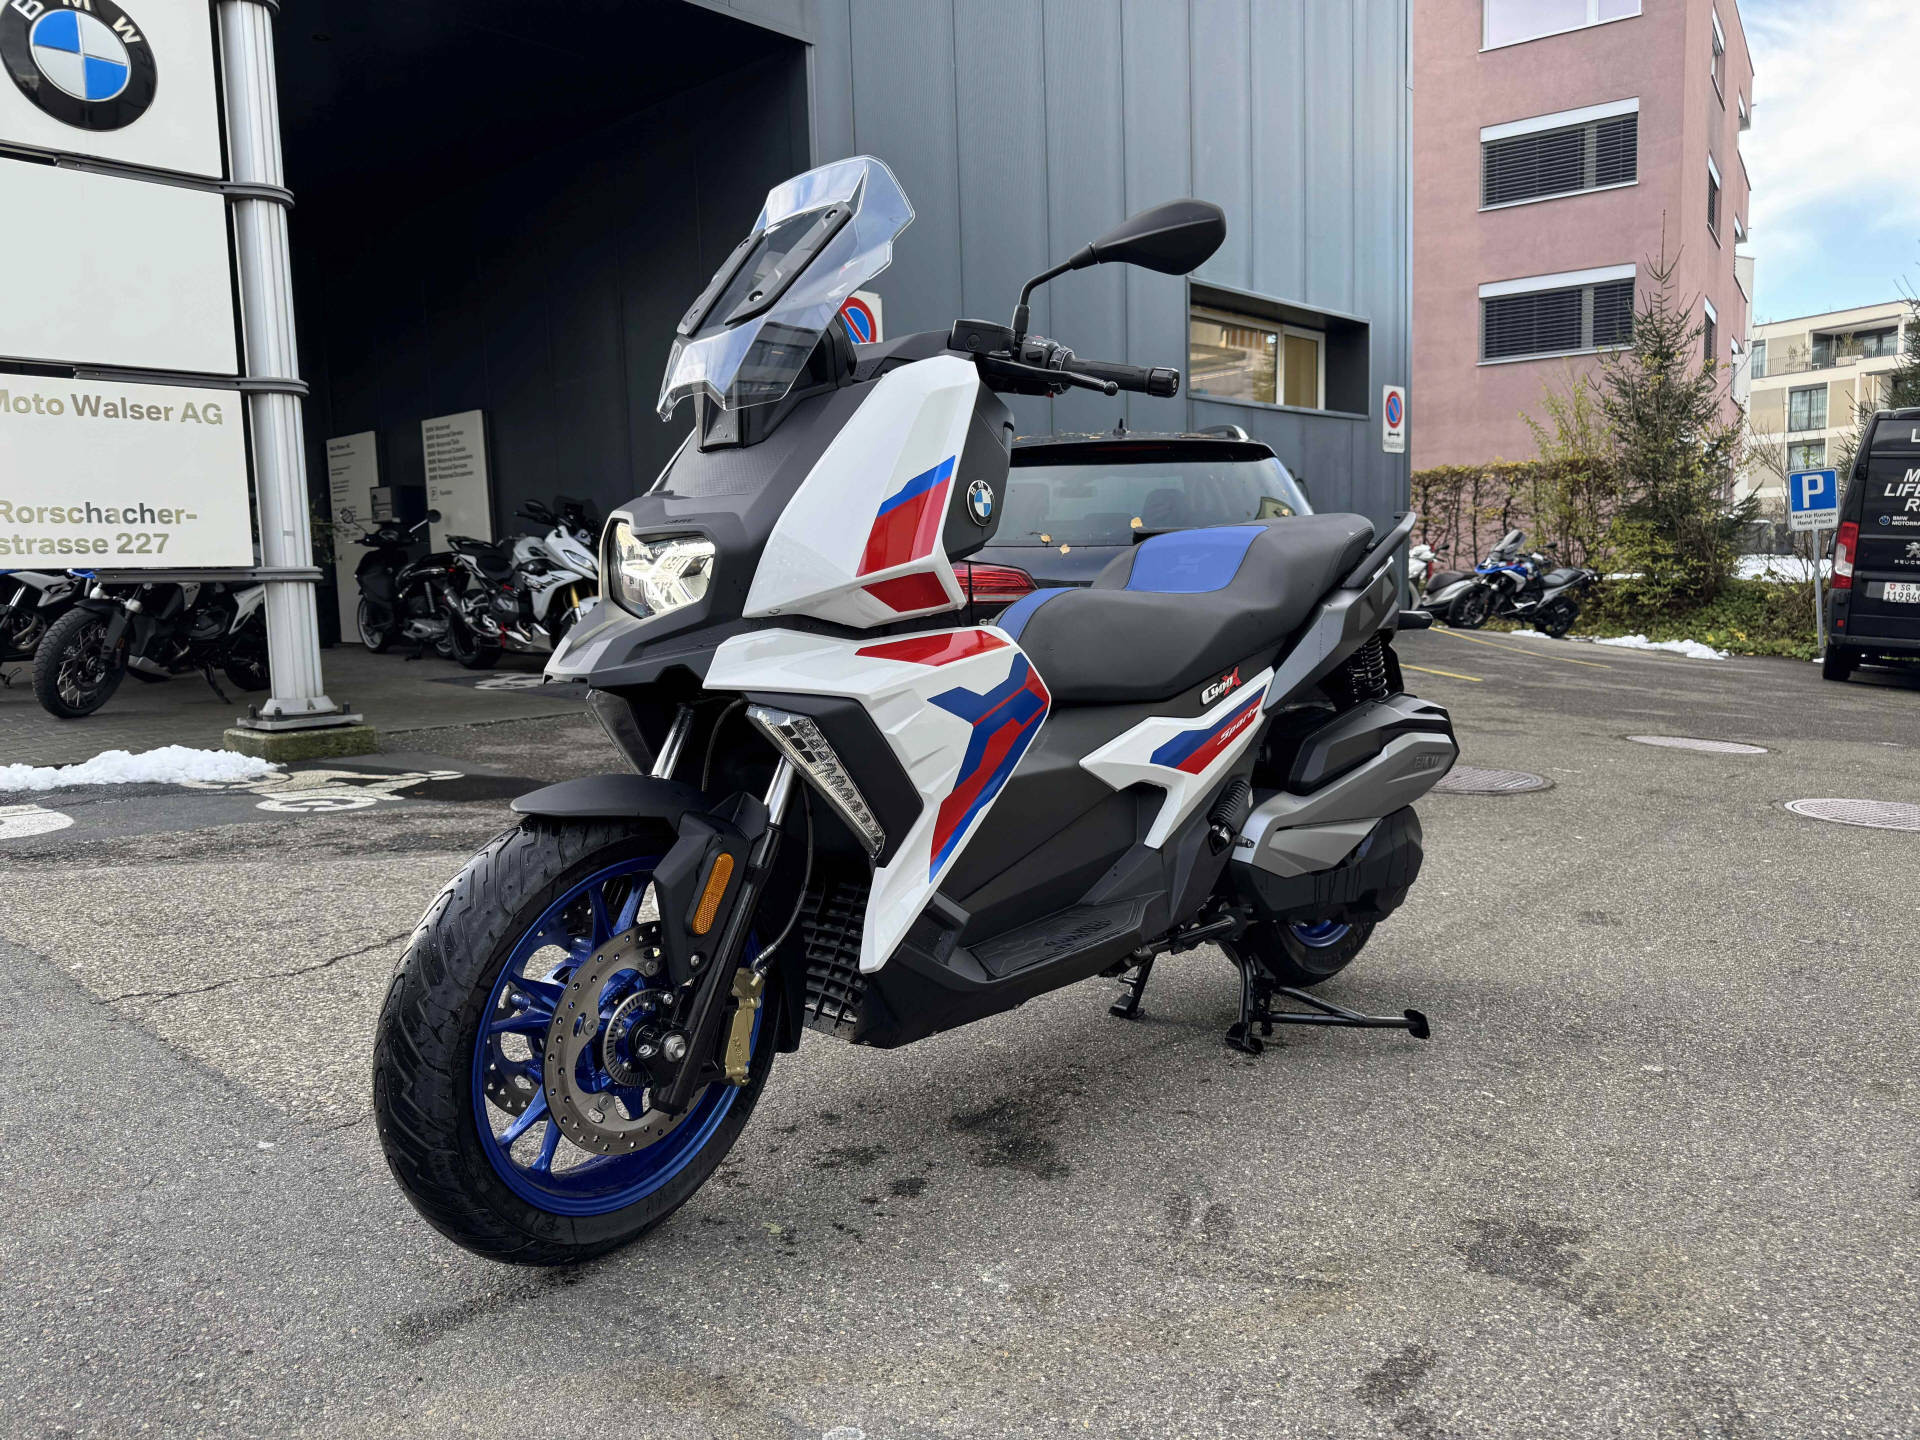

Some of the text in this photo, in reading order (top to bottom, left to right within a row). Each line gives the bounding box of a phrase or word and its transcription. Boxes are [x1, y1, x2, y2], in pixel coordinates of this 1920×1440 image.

[70, 393, 174, 422] Walser
[180, 402, 223, 425] AG
[1903, 468, 1920, 482] M
[1802, 475, 1824, 509] P
[0, 501, 198, 525] Rorschacher-
[1904, 498, 1920, 512] R
[0, 532, 170, 555] strasse 227
[1217, 705, 1261, 746] Sport
